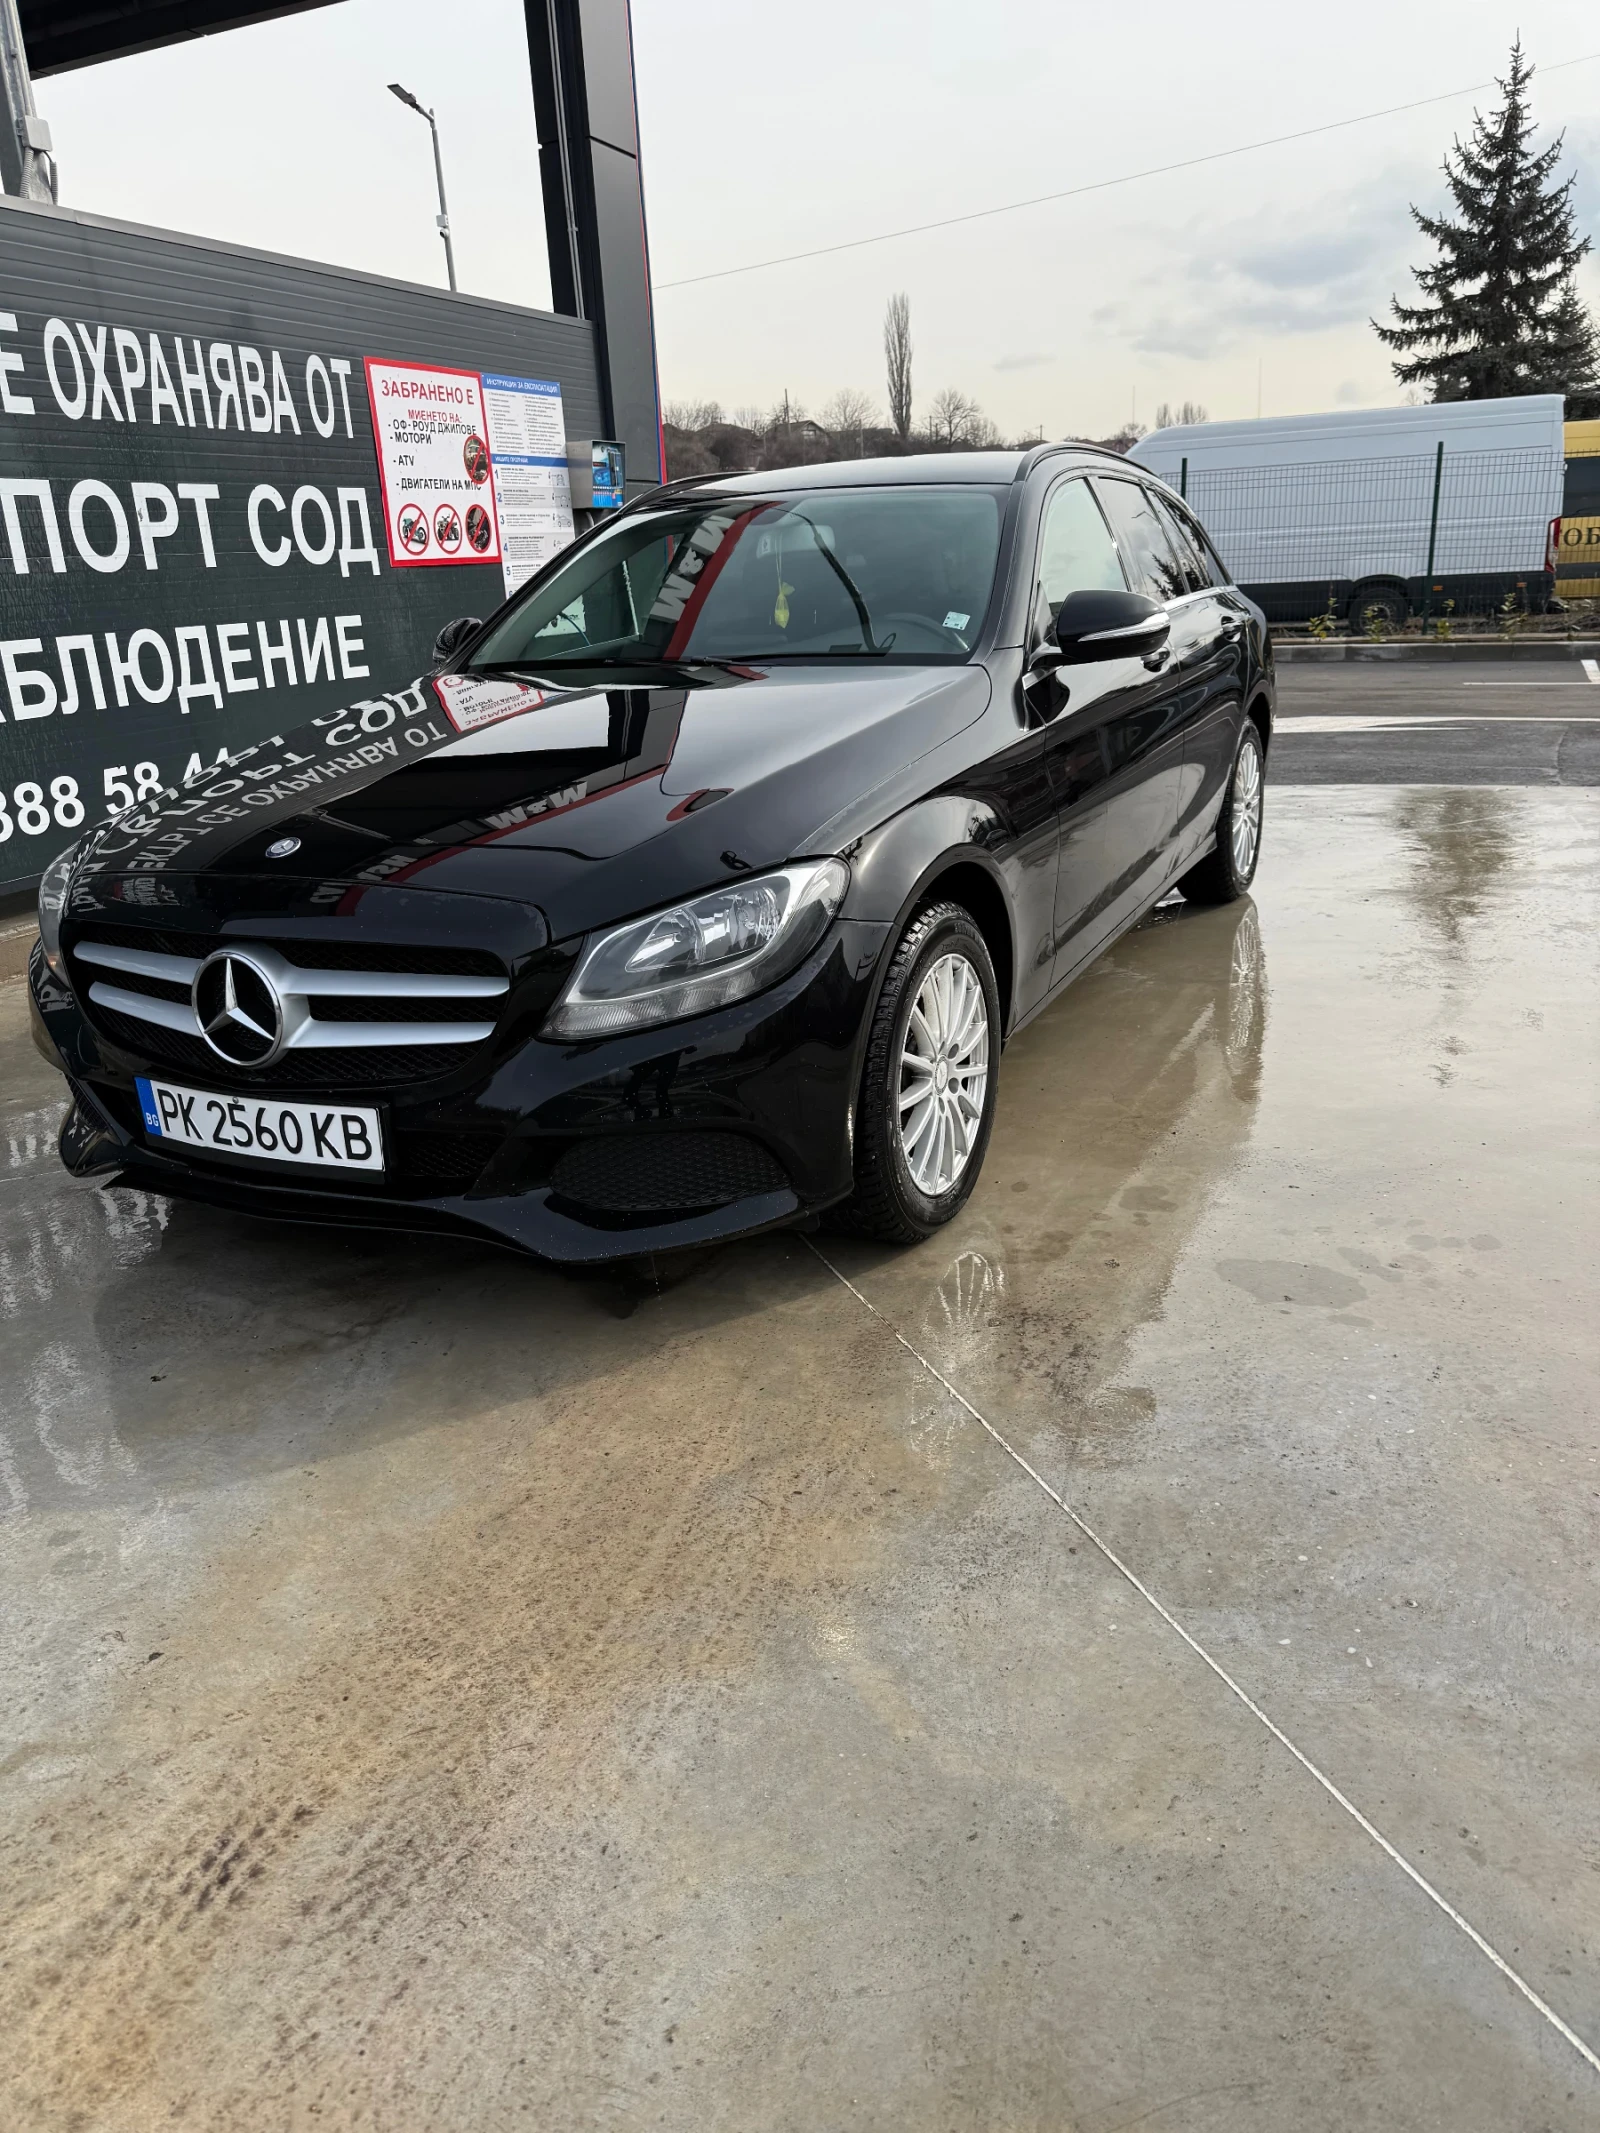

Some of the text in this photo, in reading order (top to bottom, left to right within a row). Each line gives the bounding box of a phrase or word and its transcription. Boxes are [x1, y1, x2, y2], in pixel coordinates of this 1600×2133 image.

[43, 317, 302, 435] ОХРАНЯВА
[305, 353, 354, 439] ОТ
[381, 379, 475, 405] ЗАБРАНЕНО Е
[407, 409, 447, 423] МИЕНЕТО
[437, 422, 477, 436] ДЖИПОВЕ
[394, 431, 432, 445] МОТОРИ
[398, 454, 415, 467] ATV
[401, 477, 451, 492] ДВИГАТЕЛИ
[451, 479, 464, 491] НА
[499, 514, 505, 525] 3
[247, 483, 381, 578] СОД
[503, 542, 509, 552] 4
[506, 566, 511, 576] 5
[0, 614, 370, 723] БЛЮДЕНИЕ
[145, 1112, 160, 1128] BG
[157, 1088, 372, 1161] PK 2560 KB
